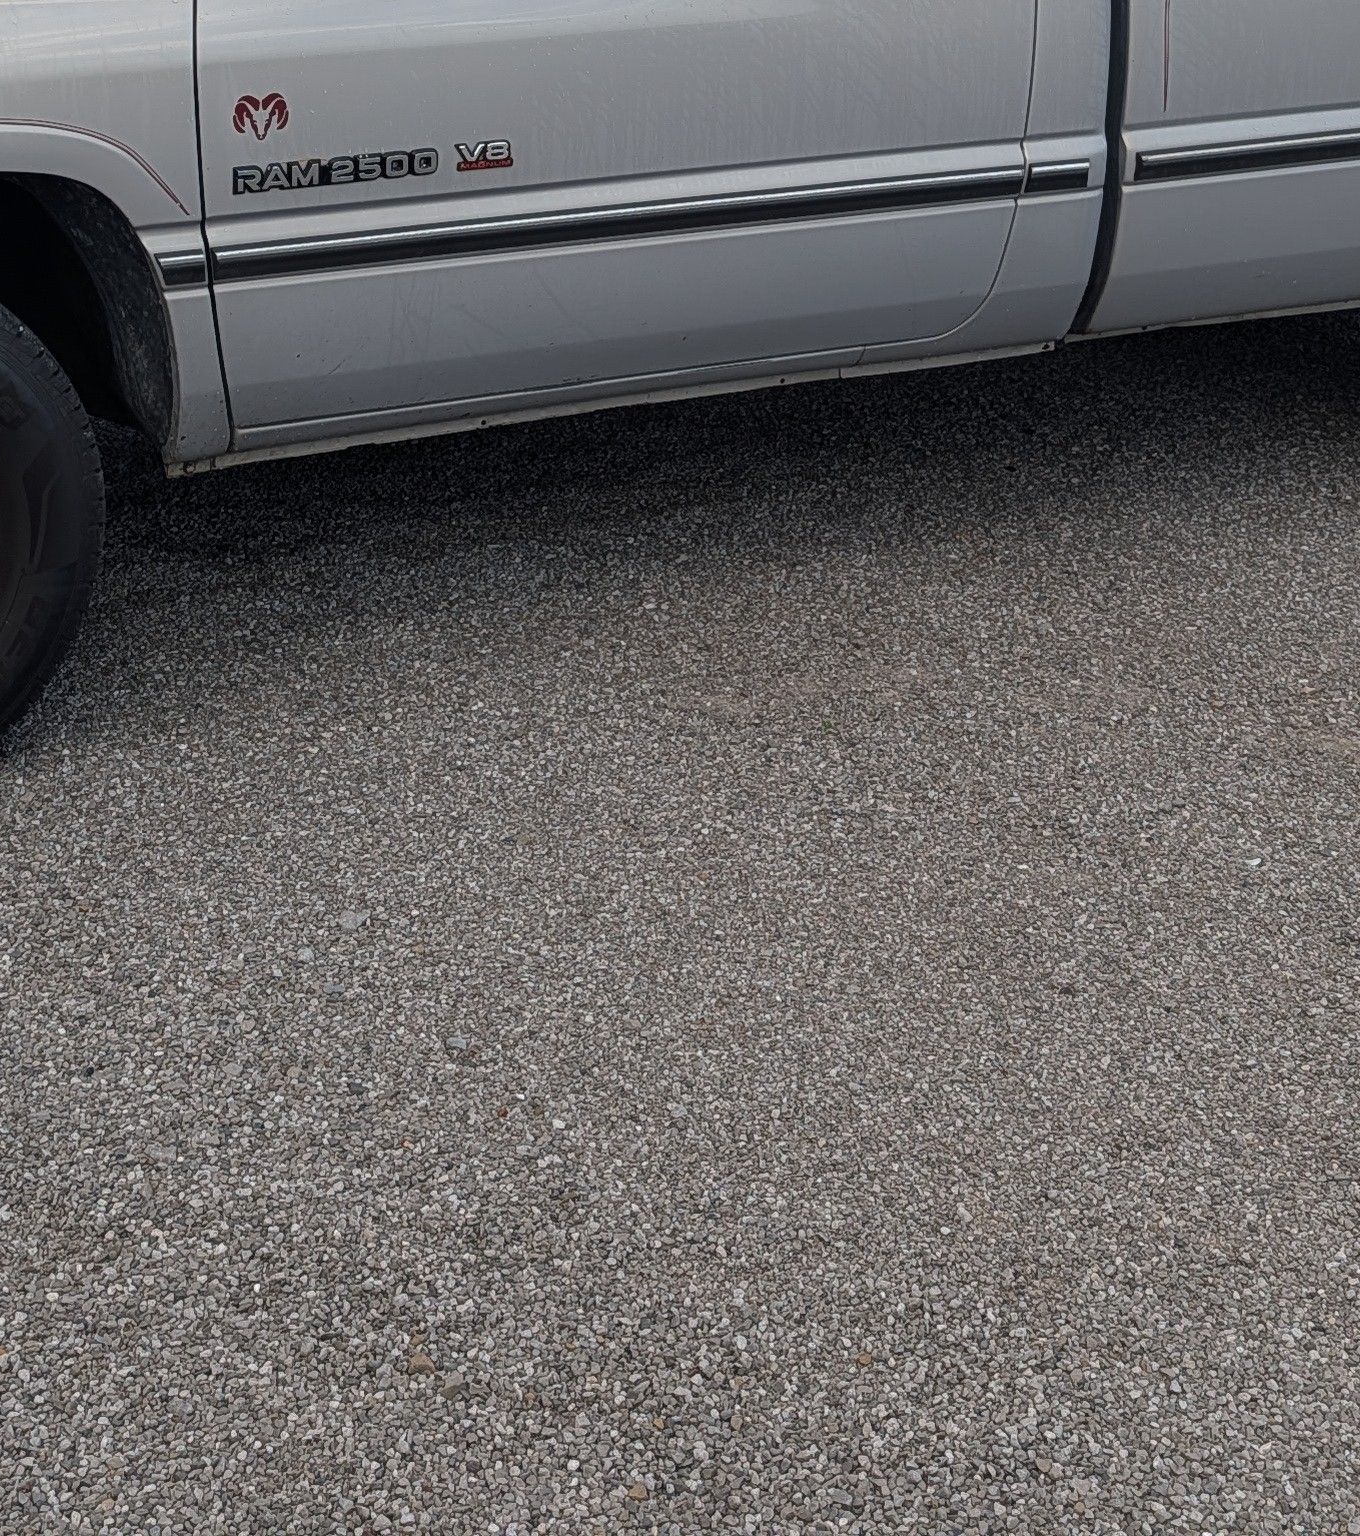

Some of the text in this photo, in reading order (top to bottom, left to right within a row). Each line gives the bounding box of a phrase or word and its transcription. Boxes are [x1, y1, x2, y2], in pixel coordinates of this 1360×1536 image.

[236, 140, 510, 193] RAM 2500 V8
[459, 159, 511, 169] MAGNUM
